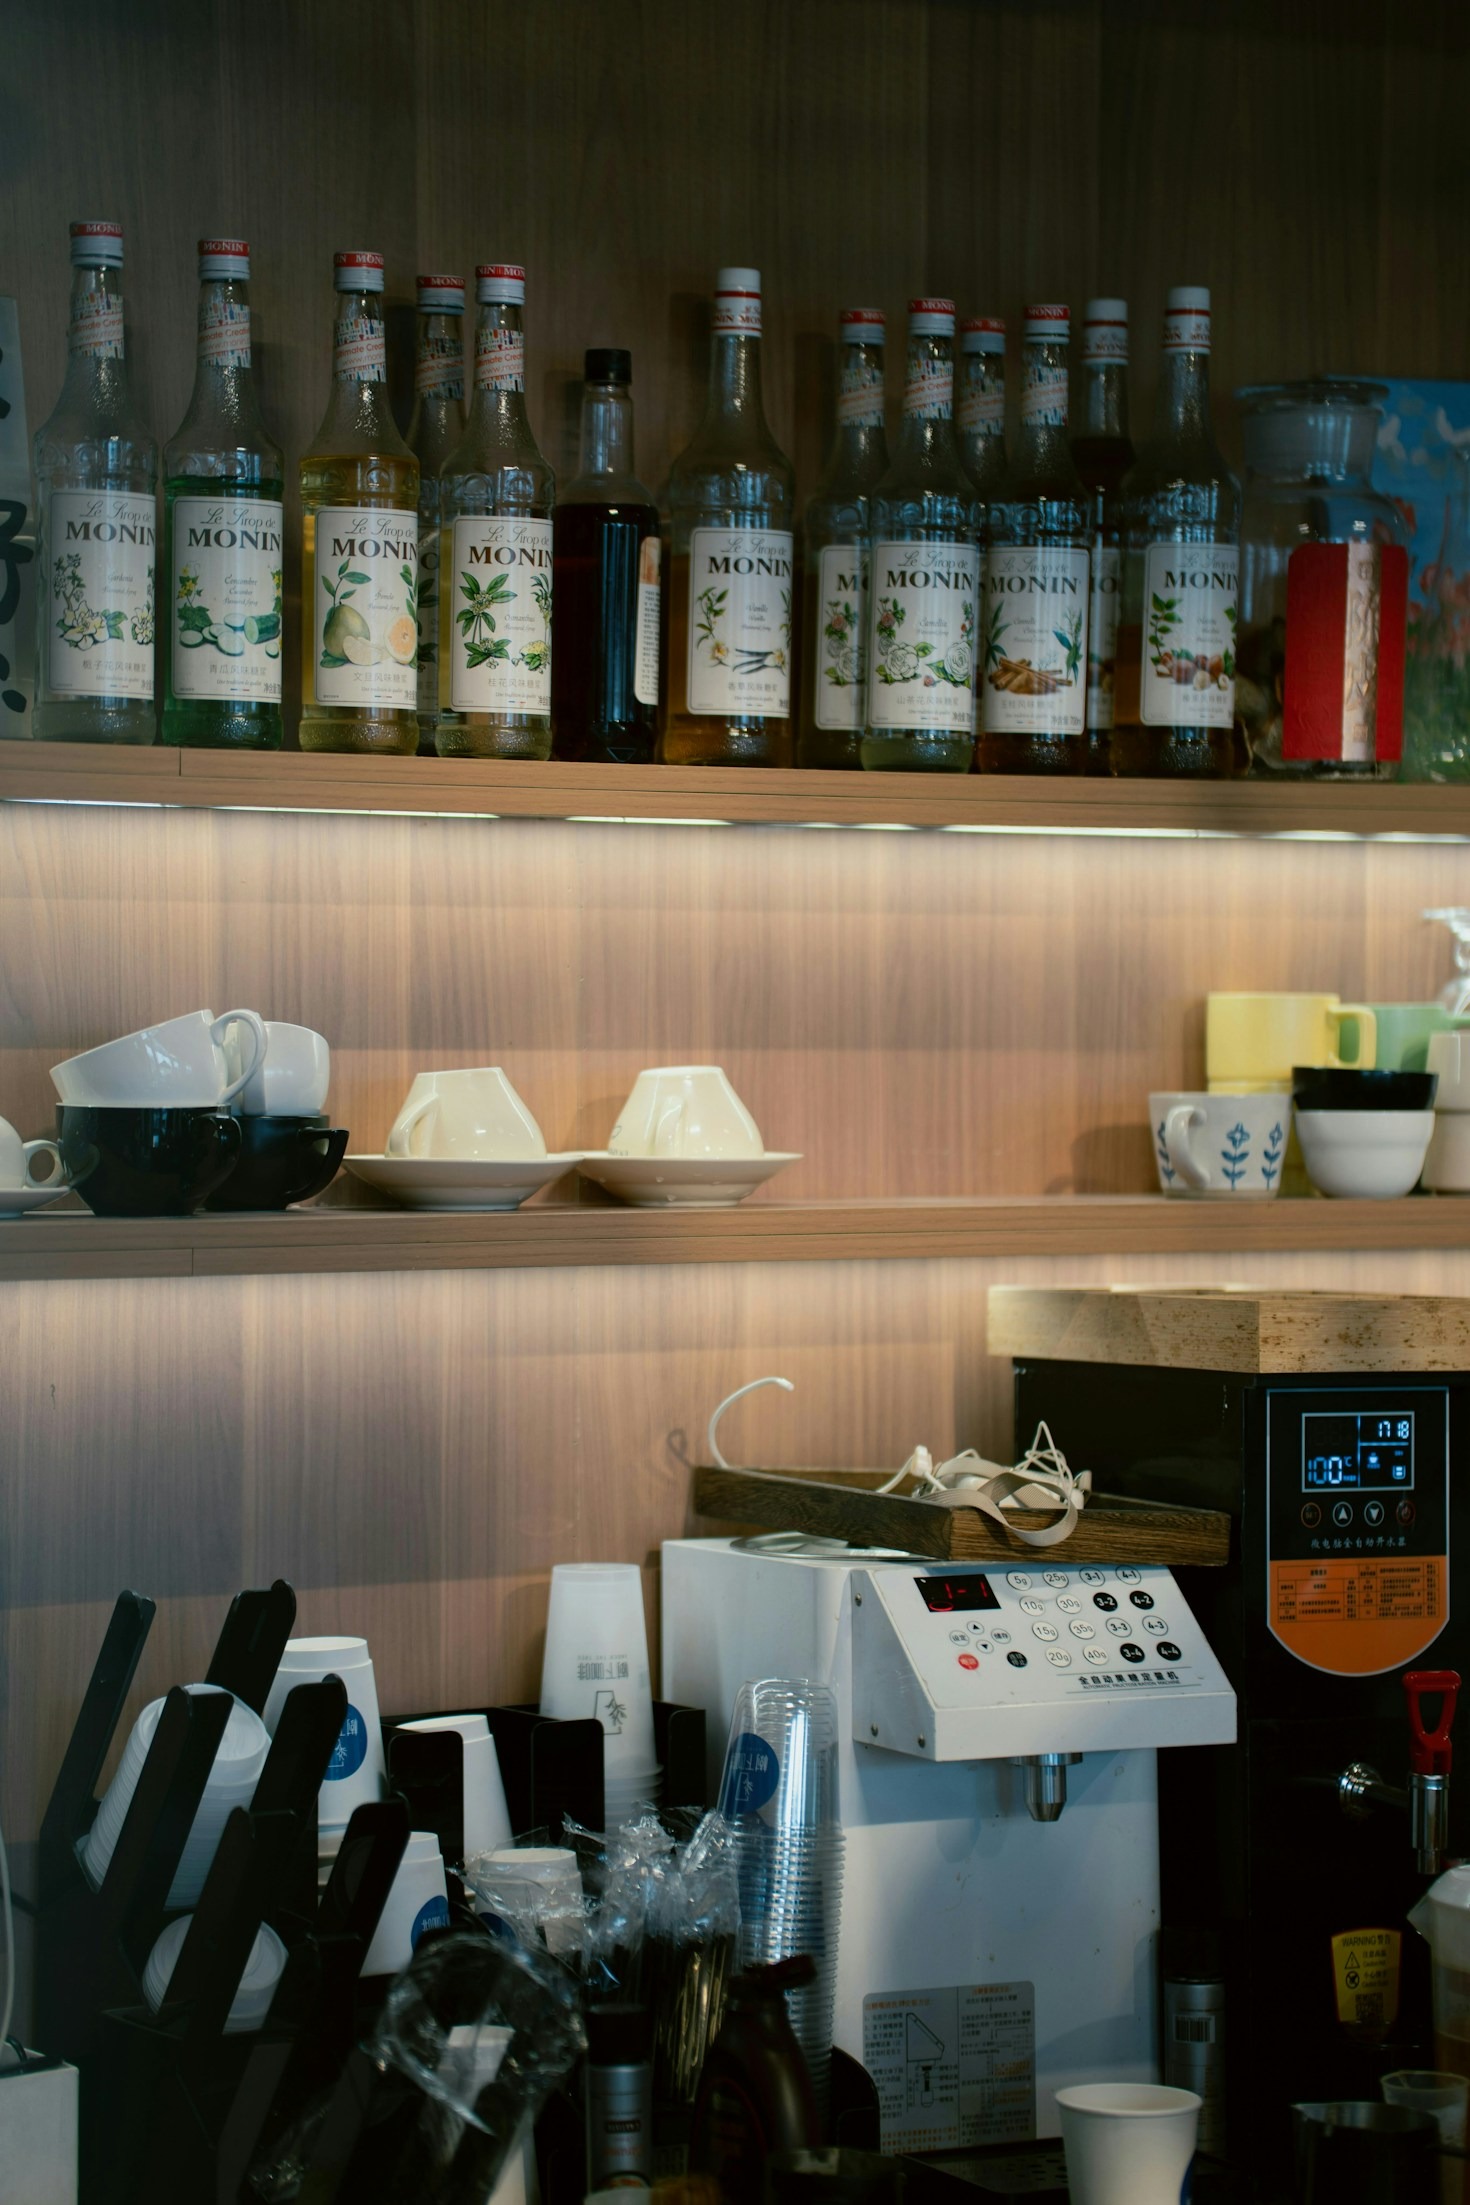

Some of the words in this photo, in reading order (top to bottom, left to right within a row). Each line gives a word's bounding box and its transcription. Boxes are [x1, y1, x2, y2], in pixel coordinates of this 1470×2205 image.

[204, 242, 244, 252] MONIN
[66, 520, 155, 547] MONIN
[188, 528, 281, 552] MONIN
[332, 538, 417, 561] MONIN
[468, 546, 552, 568] MONIN
[708, 556, 792, 577] MONIN
[886, 570, 974, 590] MONIN
[990, 576, 1078, 595] MONIN
[1047, 1573, 1067, 1584] 25g
[1084, 1571, 1101, 1581] 3-1
[1121, 1569, 1137, 1579] 4-1
[1014, 1575, 1027, 1587] 5g
[1025, 1600, 1044, 1612] 10g
[1060, 1598, 1080, 1610] 30g
[1096, 1597, 1115, 1606] 3-2
[1134, 1595, 1152, 1605] 4-2
[1073, 1623, 1093, 1635] 35g
[1110, 1622, 1128, 1632] 3-3
[1147, 1620, 1164, 1630] 4-3
[1036, 1627, 1056, 1638] 15g
[1049, 1651, 1069, 1663] 20g
[1088, 1649, 1107, 1661] 40g
[1123, 1648, 1142, 1658] 3-4
[1160, 1646, 1178, 1656] 4-4
[1342, 1935, 1376, 1948] WARNING
